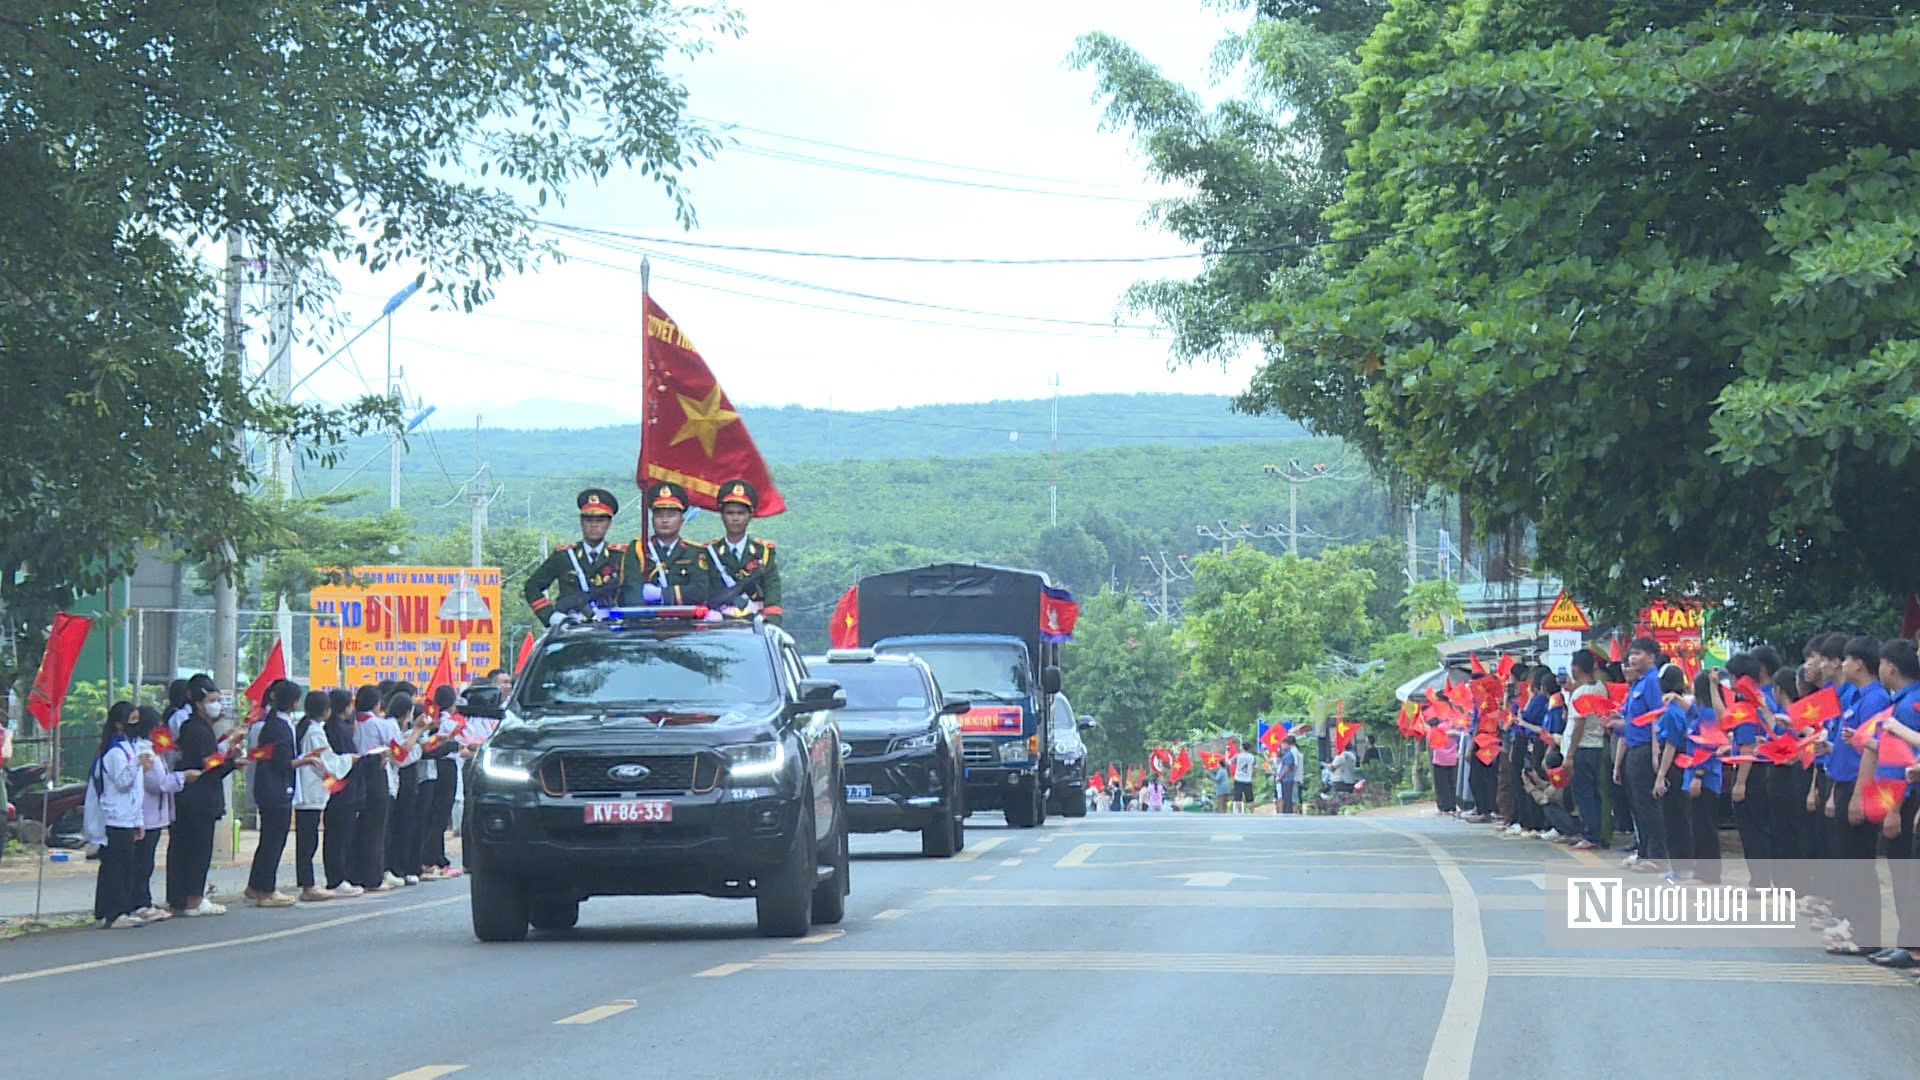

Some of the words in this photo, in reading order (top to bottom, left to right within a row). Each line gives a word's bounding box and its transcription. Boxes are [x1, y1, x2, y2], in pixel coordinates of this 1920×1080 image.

[386, 572, 407, 584] MTV
[410, 572, 434, 584] NAM
[437, 572, 461, 586] ĐỊN
[483, 573, 498, 585] LAI
[317, 601, 362, 627] VLXD
[365, 595, 429, 639] ĐỊNH
[1553, 639, 1577, 648] SLOW
[593, 804, 664, 821] KV-86-33
